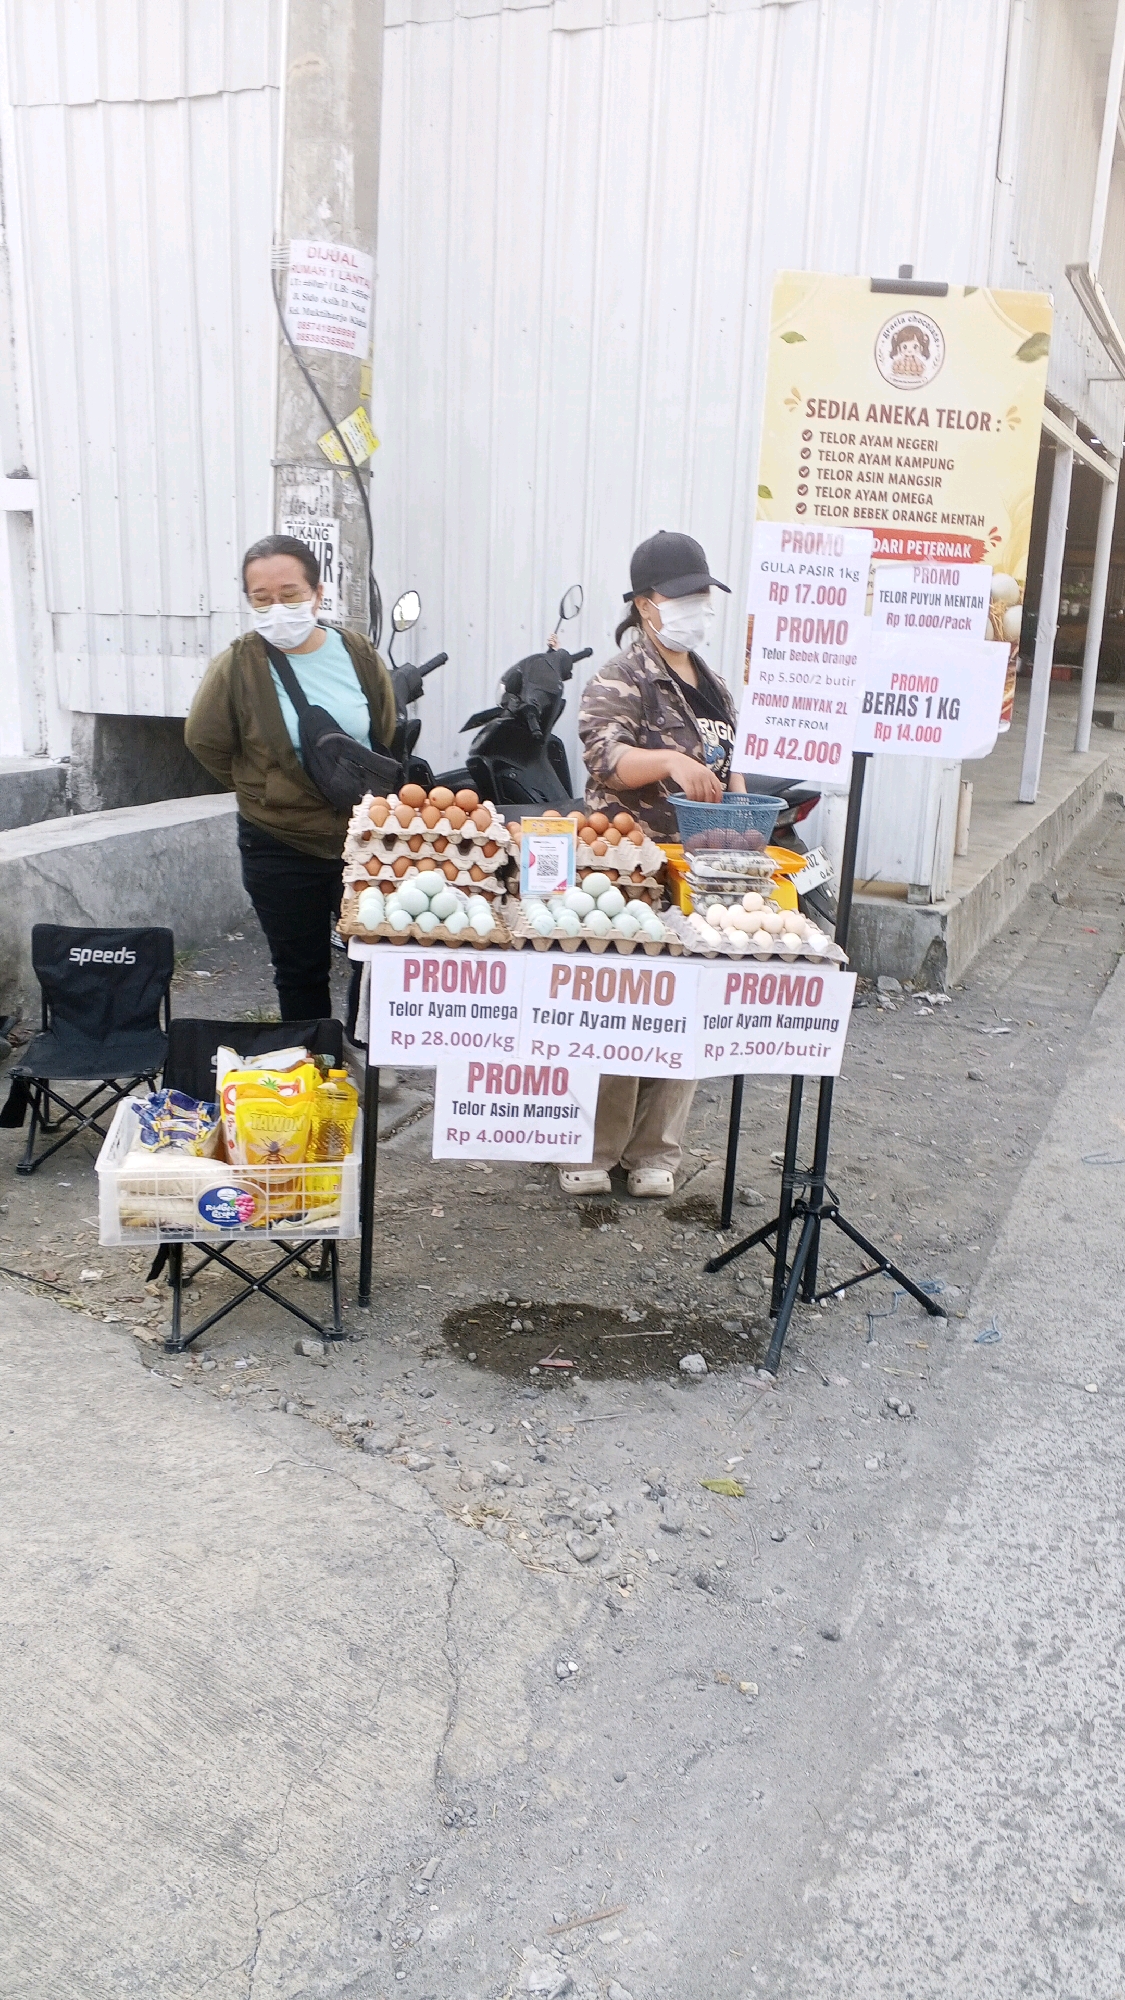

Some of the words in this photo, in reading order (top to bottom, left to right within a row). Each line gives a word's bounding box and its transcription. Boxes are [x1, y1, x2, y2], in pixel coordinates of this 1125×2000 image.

[307, 246, 358, 268] DIJUAL
[806, 398, 860, 422] SEDIA
[865, 403, 930, 428] ANEKA
[936, 408, 992, 432] TELOR
[819, 431, 856, 446] TELOR
[859, 434, 893, 449] AYAM
[897, 437, 938, 452] NEGERI
[818, 449, 854, 464] TELOR
[858, 452, 892, 467] AYAM
[895, 455, 955, 471] KAMPUNG
[817, 467, 853, 482] TELOR
[856, 471, 884, 484] ASIN
[888, 473, 942, 488] MANGSIR
[815, 485, 851, 500] TELOR
[855, 488, 888, 502] AYAM
[892, 491, 933, 505] OMEGA
[814, 504, 849, 518] TELOR
[853, 506, 889, 521] BEBEK
[892, 509, 937, 524] ORANGE
[941, 512, 985, 527] MENTAH
[287, 525, 329, 541] TUKANG
[781, 529, 845, 557] PROMO
[873, 538, 903, 555] DARI
[906, 539, 972, 558] PETERNAK
[760, 561, 795, 574] GULA
[799, 564, 835, 578] PASIR
[839, 567, 860, 582] 1kg
[913, 565, 960, 586] PROMO
[769, 581, 789, 605] Rp
[795, 583, 847, 607] 17.000
[879, 590, 908, 604] TELOR
[910, 592, 942, 607] PUYUH
[944, 594, 984, 609] MENTAH
[775, 615, 849, 646] PROMO
[886, 612, 901, 627] Rp
[904, 613, 972, 631] 10.000/Pack
[762, 647, 787, 661] Telor
[789, 649, 820, 664] Bebek
[822, 651, 858, 667] Orange
[759, 671, 775, 685] Rp
[778, 671, 822, 686] 5.500/2
[825, 674, 857, 687] butir
[890, 673, 939, 693] PROMO
[752, 692, 789, 709] PROMO
[792, 696, 833, 714] MINYAK
[835, 701, 848, 716] 2L
[861, 690, 919, 717] BERAS
[925, 695, 933, 719] 1
[937, 696, 961, 721] KG
[765, 716, 796, 728] START
[798, 719, 829, 731] FROM
[873, 722, 892, 742] Rp
[896, 723, 942, 743] 14.000
[744, 733, 769, 760] Rp
[774, 736, 842, 765] 42.000
[69, 946, 137, 967] speeds
[403, 958, 507, 995] PROMO
[549, 963, 677, 1007] PROMO
[723, 972, 824, 1008] PROMO
[389, 1001, 424, 1017] Telor
[428, 1001, 466, 1019] Ayam
[471, 1003, 518, 1020] Omega
[532, 1007, 575, 1028] Telor
[579, 1010, 627, 1031] Ayam
[631, 1013, 687, 1034] Negeri
[703, 1014, 733, 1031] Telor
[736, 1013, 772, 1032] Ayam
[776, 1013, 840, 1033] Kampung
[390, 1030, 416, 1050] Rp
[421, 1030, 515, 1052] 28.000/kg
[704, 1042, 725, 1061] Rp
[729, 1040, 831, 1059] 2.500/butir
[531, 1039, 561, 1060] Rp
[568, 1041, 684, 1069] 24.000/kg
[467, 1061, 569, 1097] PROMO
[452, 1100, 486, 1116] Telor
[489, 1102, 520, 1118] Asin
[523, 1103, 581, 1120] Mangsir
[250, 1112, 306, 1133] TAWON
[446, 1127, 471, 1145] Rp
[476, 1128, 582, 1146] 4.000/butir
